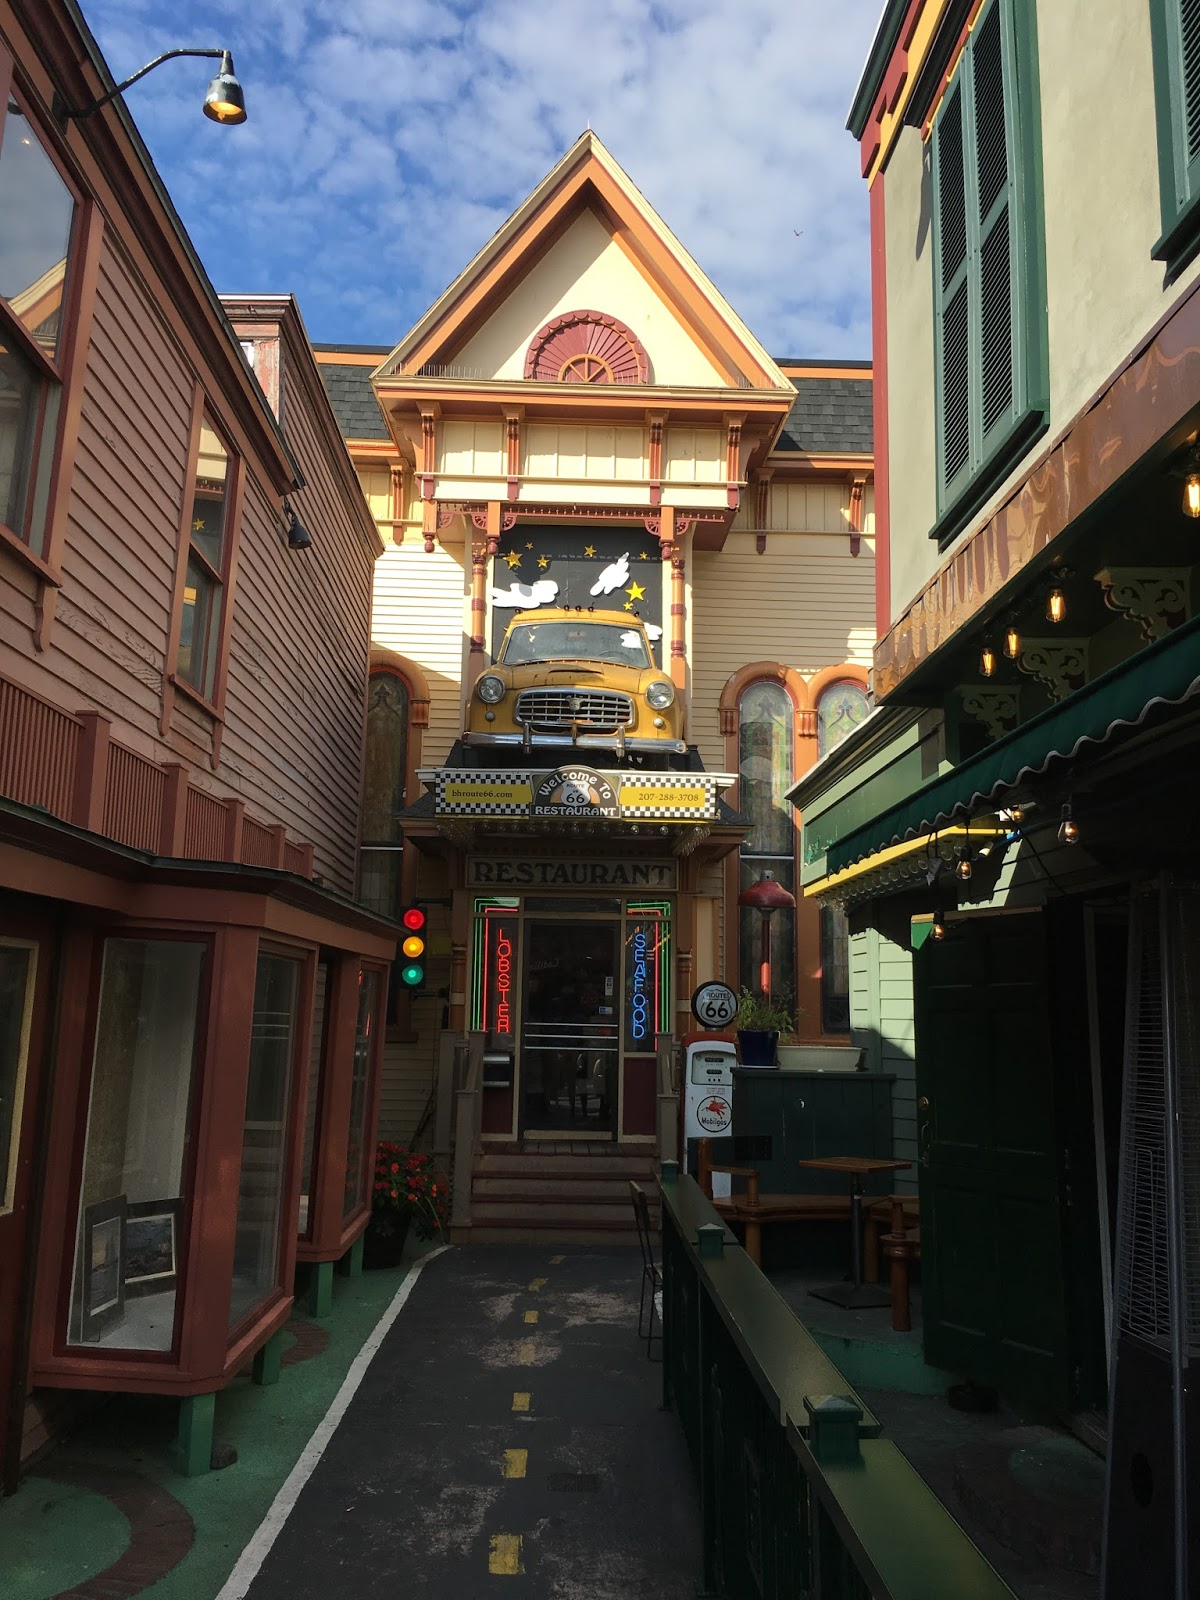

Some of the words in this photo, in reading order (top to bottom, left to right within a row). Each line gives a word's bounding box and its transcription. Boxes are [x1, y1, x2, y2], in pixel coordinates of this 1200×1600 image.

[539, 771, 598, 796] Welcome
[599, 782, 611, 799] To
[452, 789, 513, 798] bhroute66.com
[566, 793, 585, 804] 66
[638, 793, 699, 802] 207-288-3708
[535, 806, 617, 816] RESTAURANT
[474, 861, 672, 885] RESTAURANT
[497, 928, 512, 1034] LOBSTER
[633, 933, 646, 1039] SEAFOOD
[705, 1000, 729, 1019] 66
[701, 1116, 727, 1127] Mobilgas
